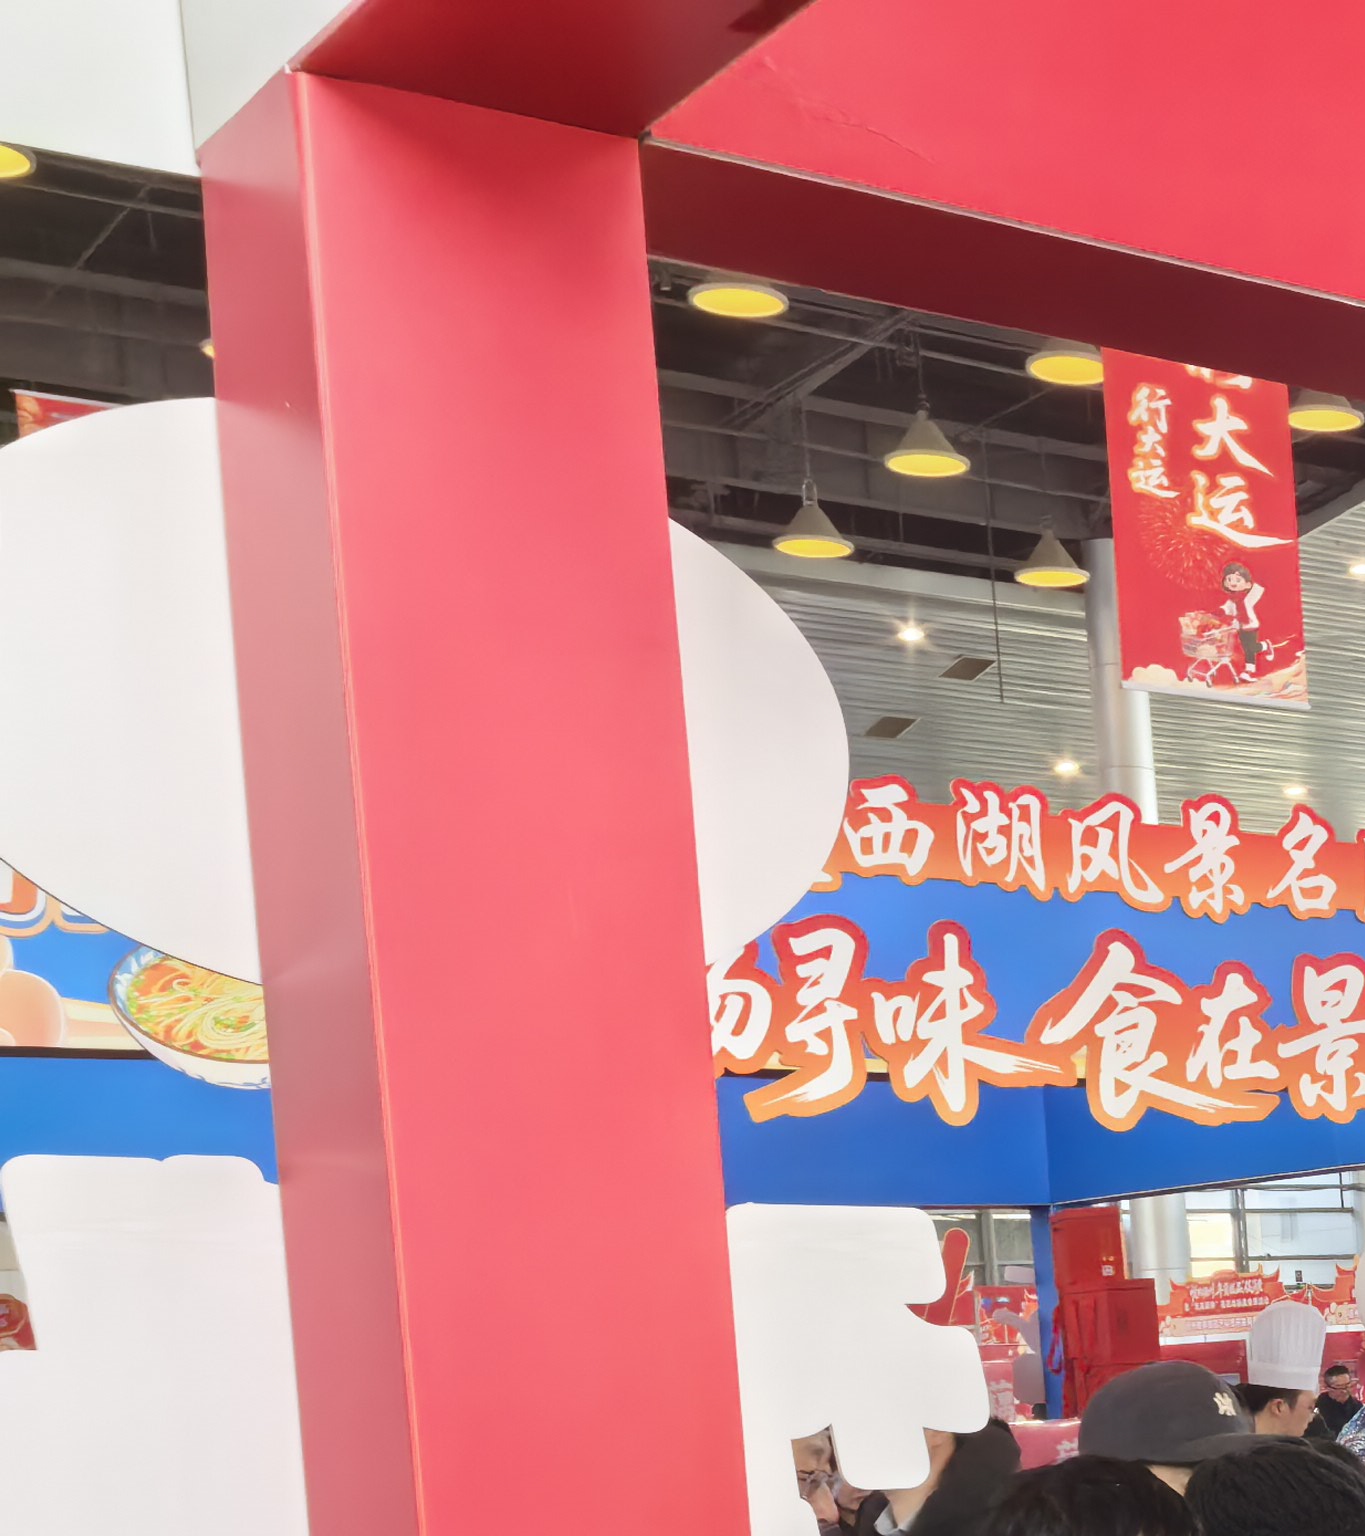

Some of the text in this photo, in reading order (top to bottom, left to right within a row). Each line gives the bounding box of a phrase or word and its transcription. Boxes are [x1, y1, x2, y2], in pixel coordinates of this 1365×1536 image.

[1130, 387, 1180, 498] 行大运
[1188, 365, 1294, 548] 大运
